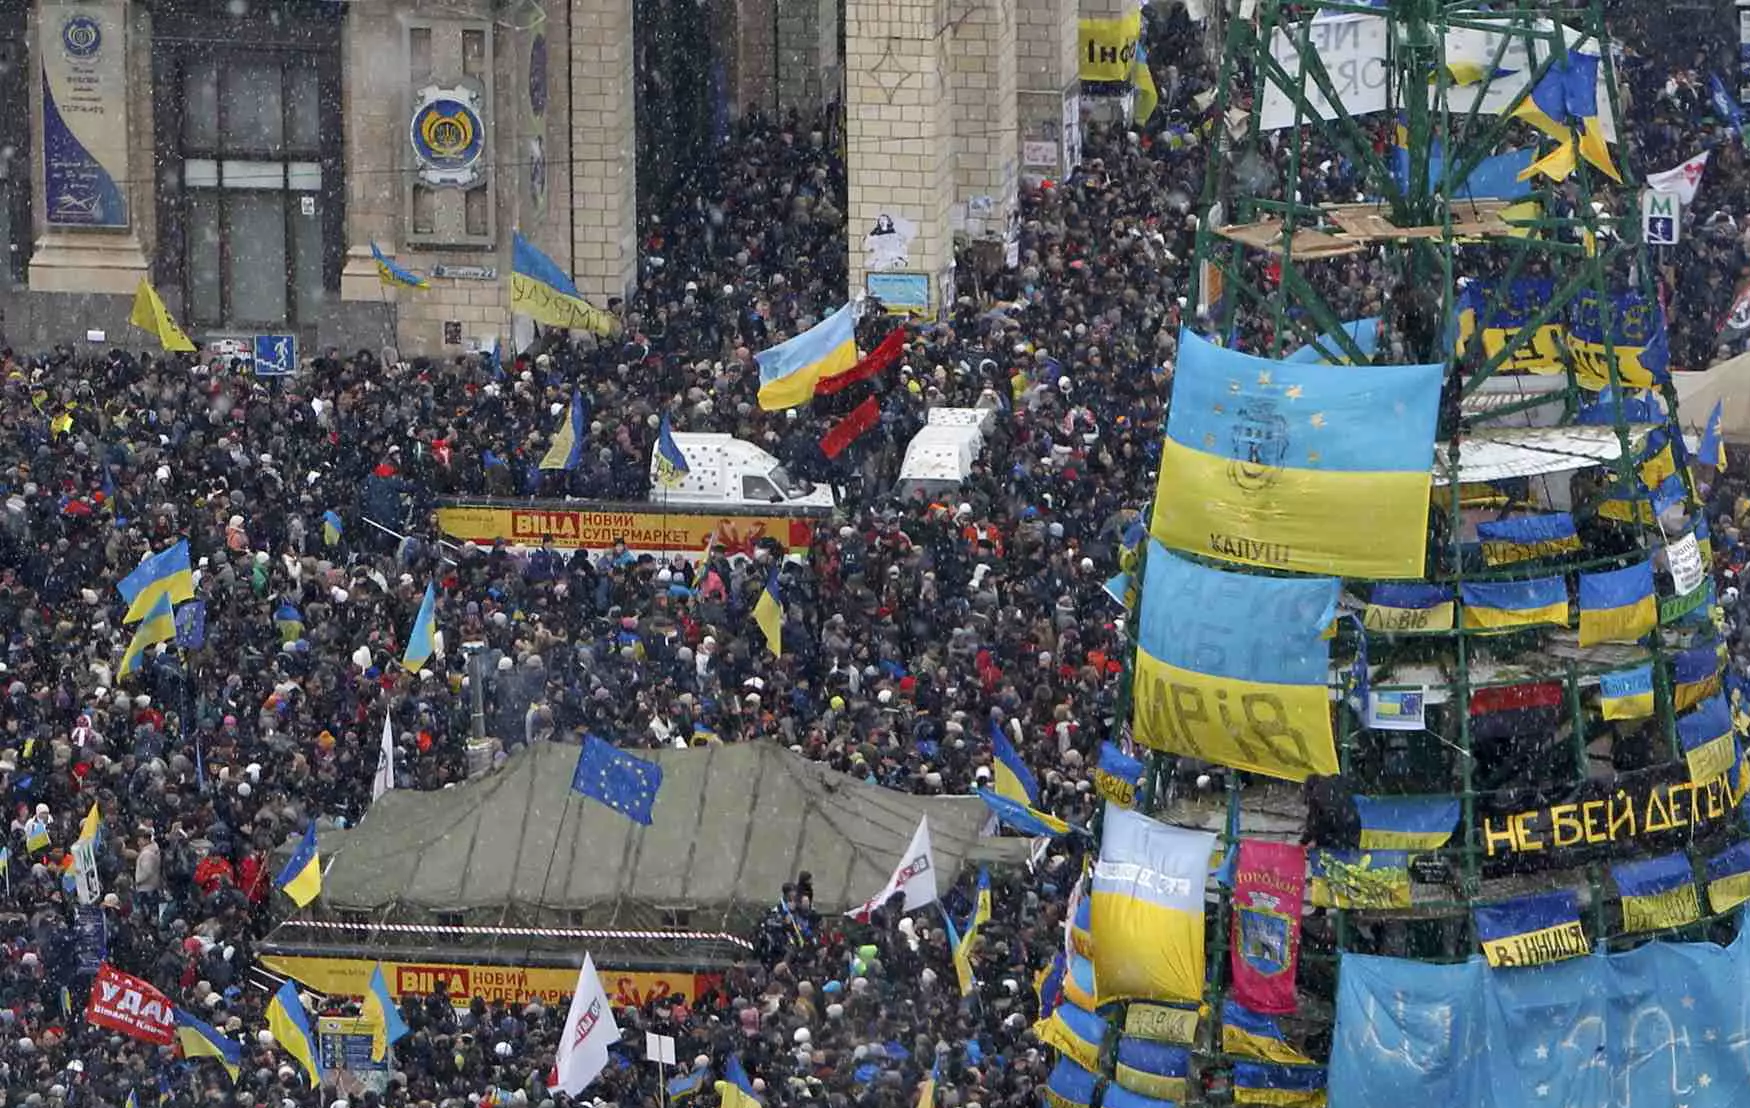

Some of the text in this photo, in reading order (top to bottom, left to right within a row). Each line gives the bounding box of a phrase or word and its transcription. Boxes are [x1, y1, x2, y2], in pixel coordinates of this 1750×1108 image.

[583, 513, 634, 527] НОВИЙ
[583, 527, 690, 543] СУПЕРМАРКЕТ
[1484, 811, 1543, 857] НЕ
[1551, 790, 1636, 846] БЕЙ
